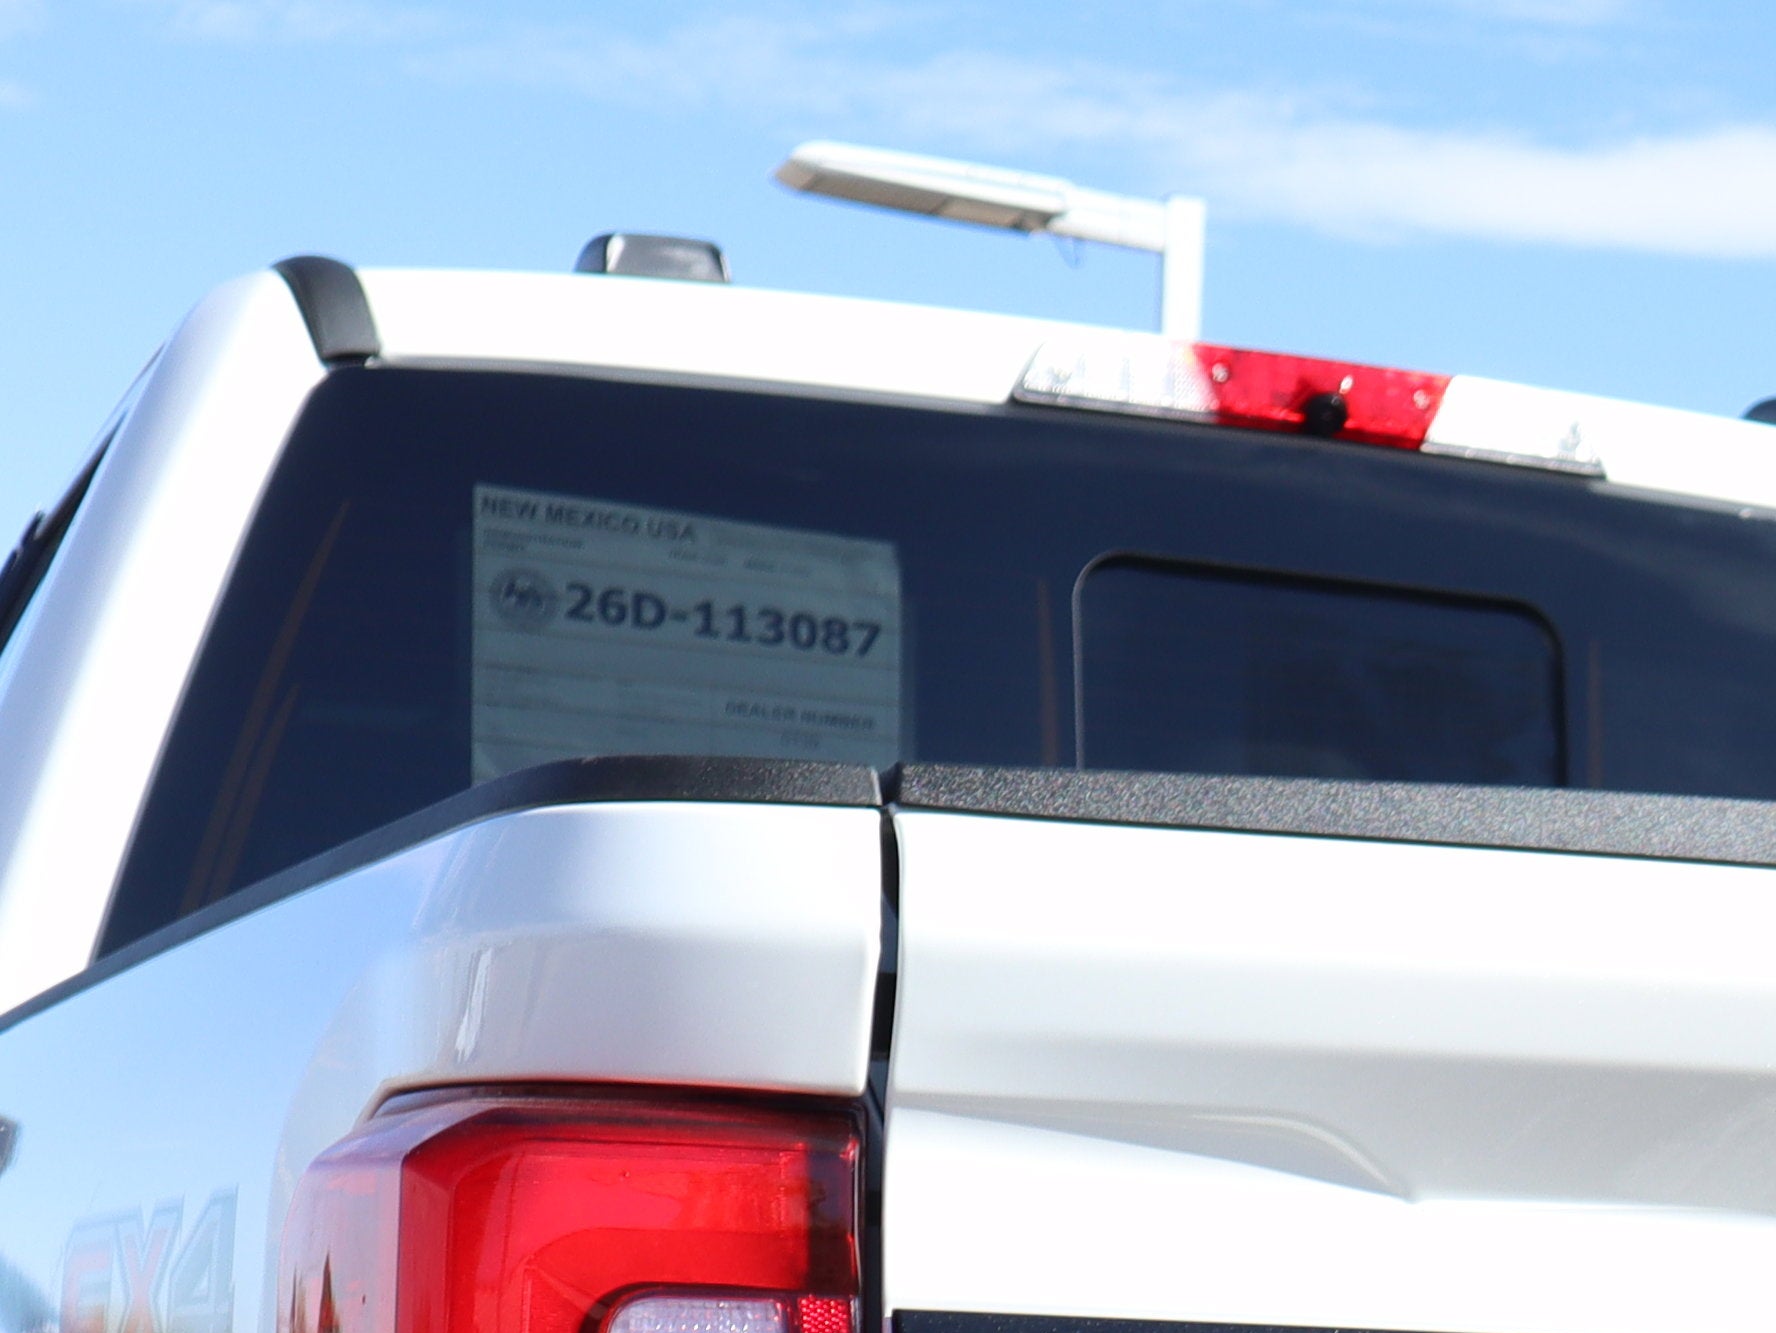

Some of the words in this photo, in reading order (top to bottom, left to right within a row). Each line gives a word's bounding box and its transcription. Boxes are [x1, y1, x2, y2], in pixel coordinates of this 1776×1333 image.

[480, 495, 537, 521] NEW
[544, 503, 641, 537] MEXICO
[647, 516, 699, 545] USA
[565, 582, 883, 657] 26D-113087
